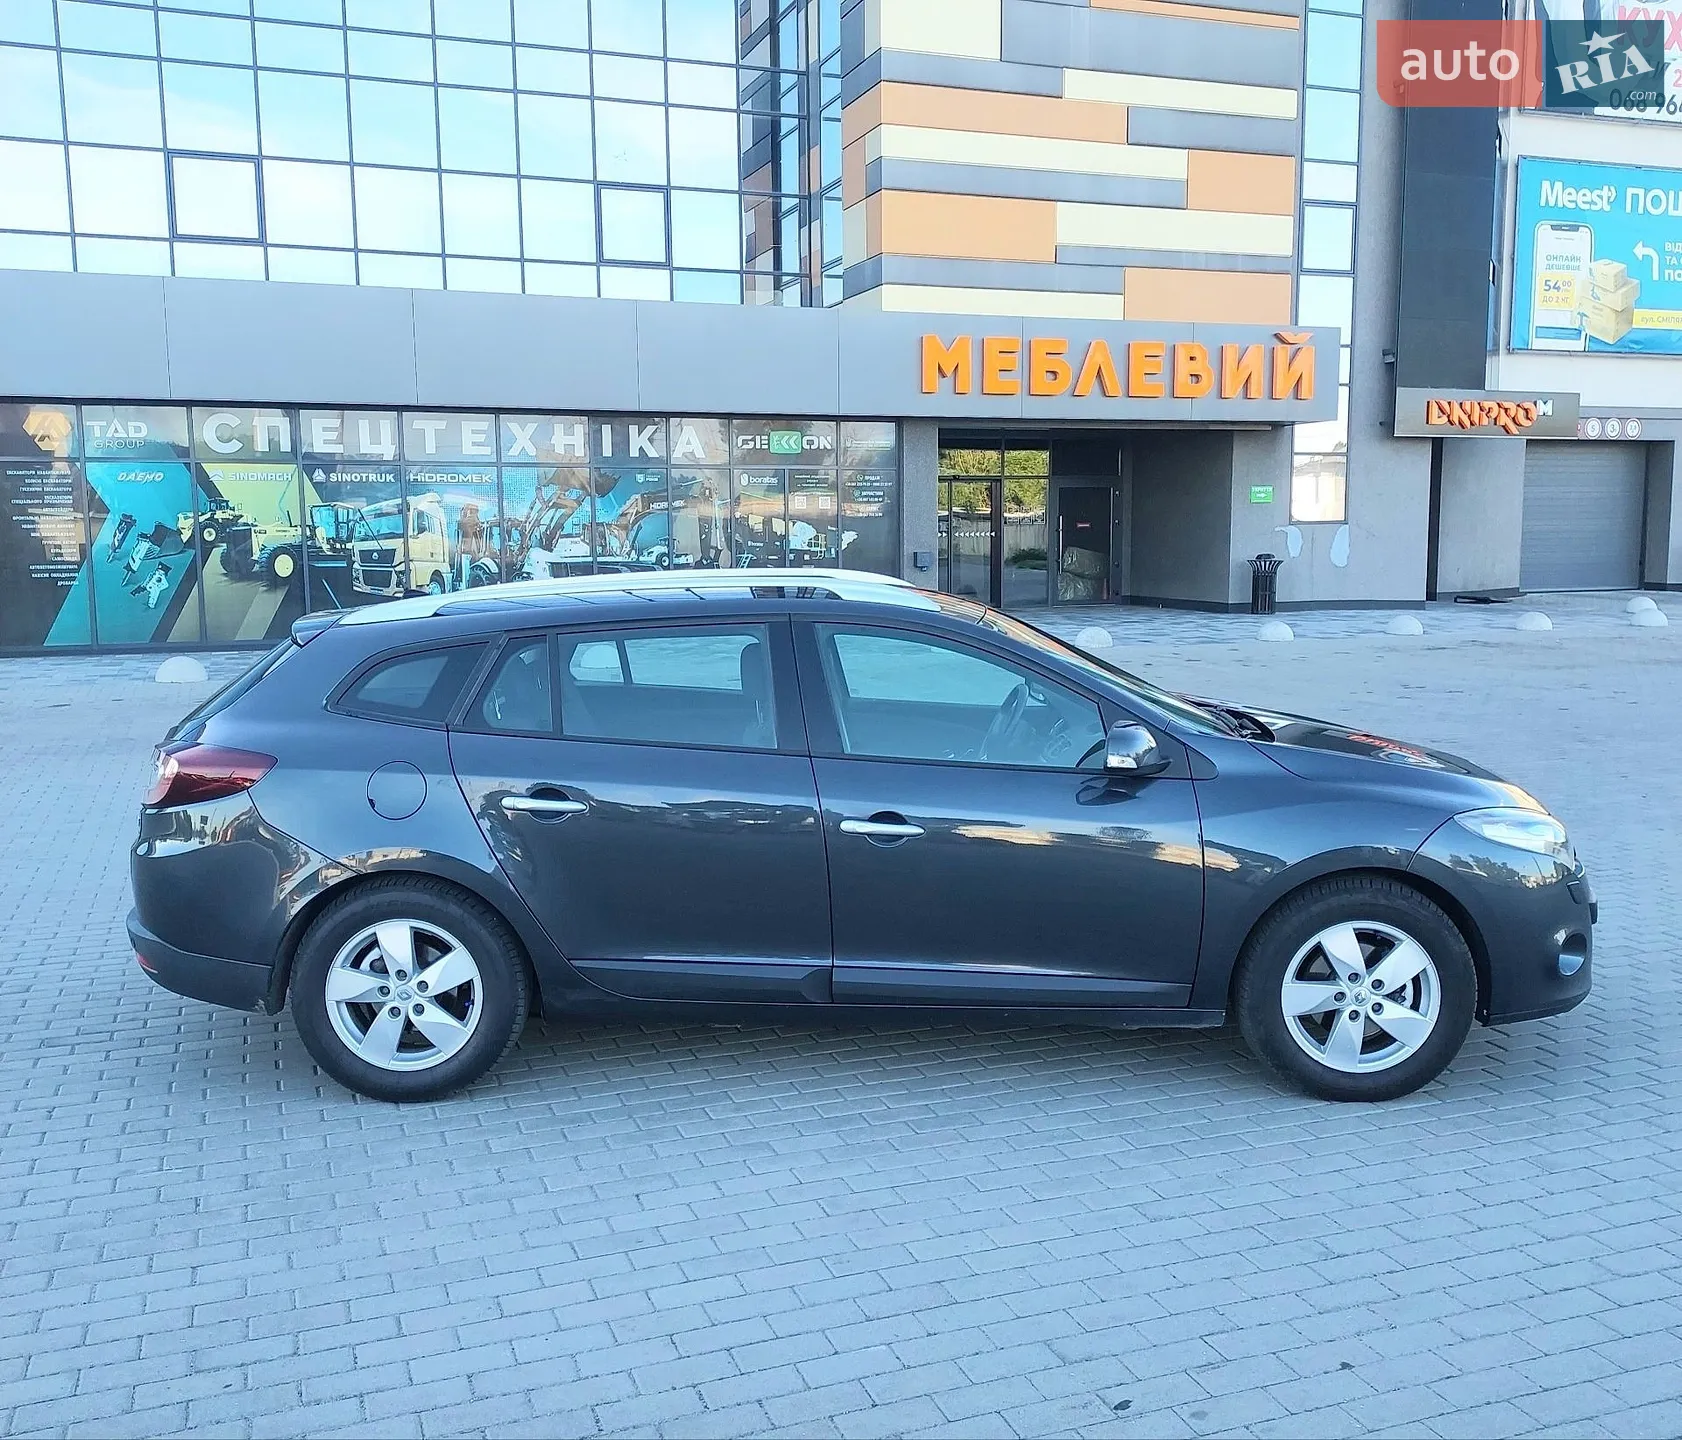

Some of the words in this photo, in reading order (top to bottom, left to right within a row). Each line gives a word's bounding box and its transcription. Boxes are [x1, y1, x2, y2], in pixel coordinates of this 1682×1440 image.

[1545, 253, 1582, 263] ОНЛАЙН
[1543, 279, 1561, 292] 54
[920, 331, 1316, 400] МЕБЛЕВИЙ
[86, 418, 148, 438] TAD
[202, 412, 706, 461] СПЕЦТЕХНІКА
[94, 439, 145, 449] GROUP
[329, 472, 396, 483] SINOTRUK
